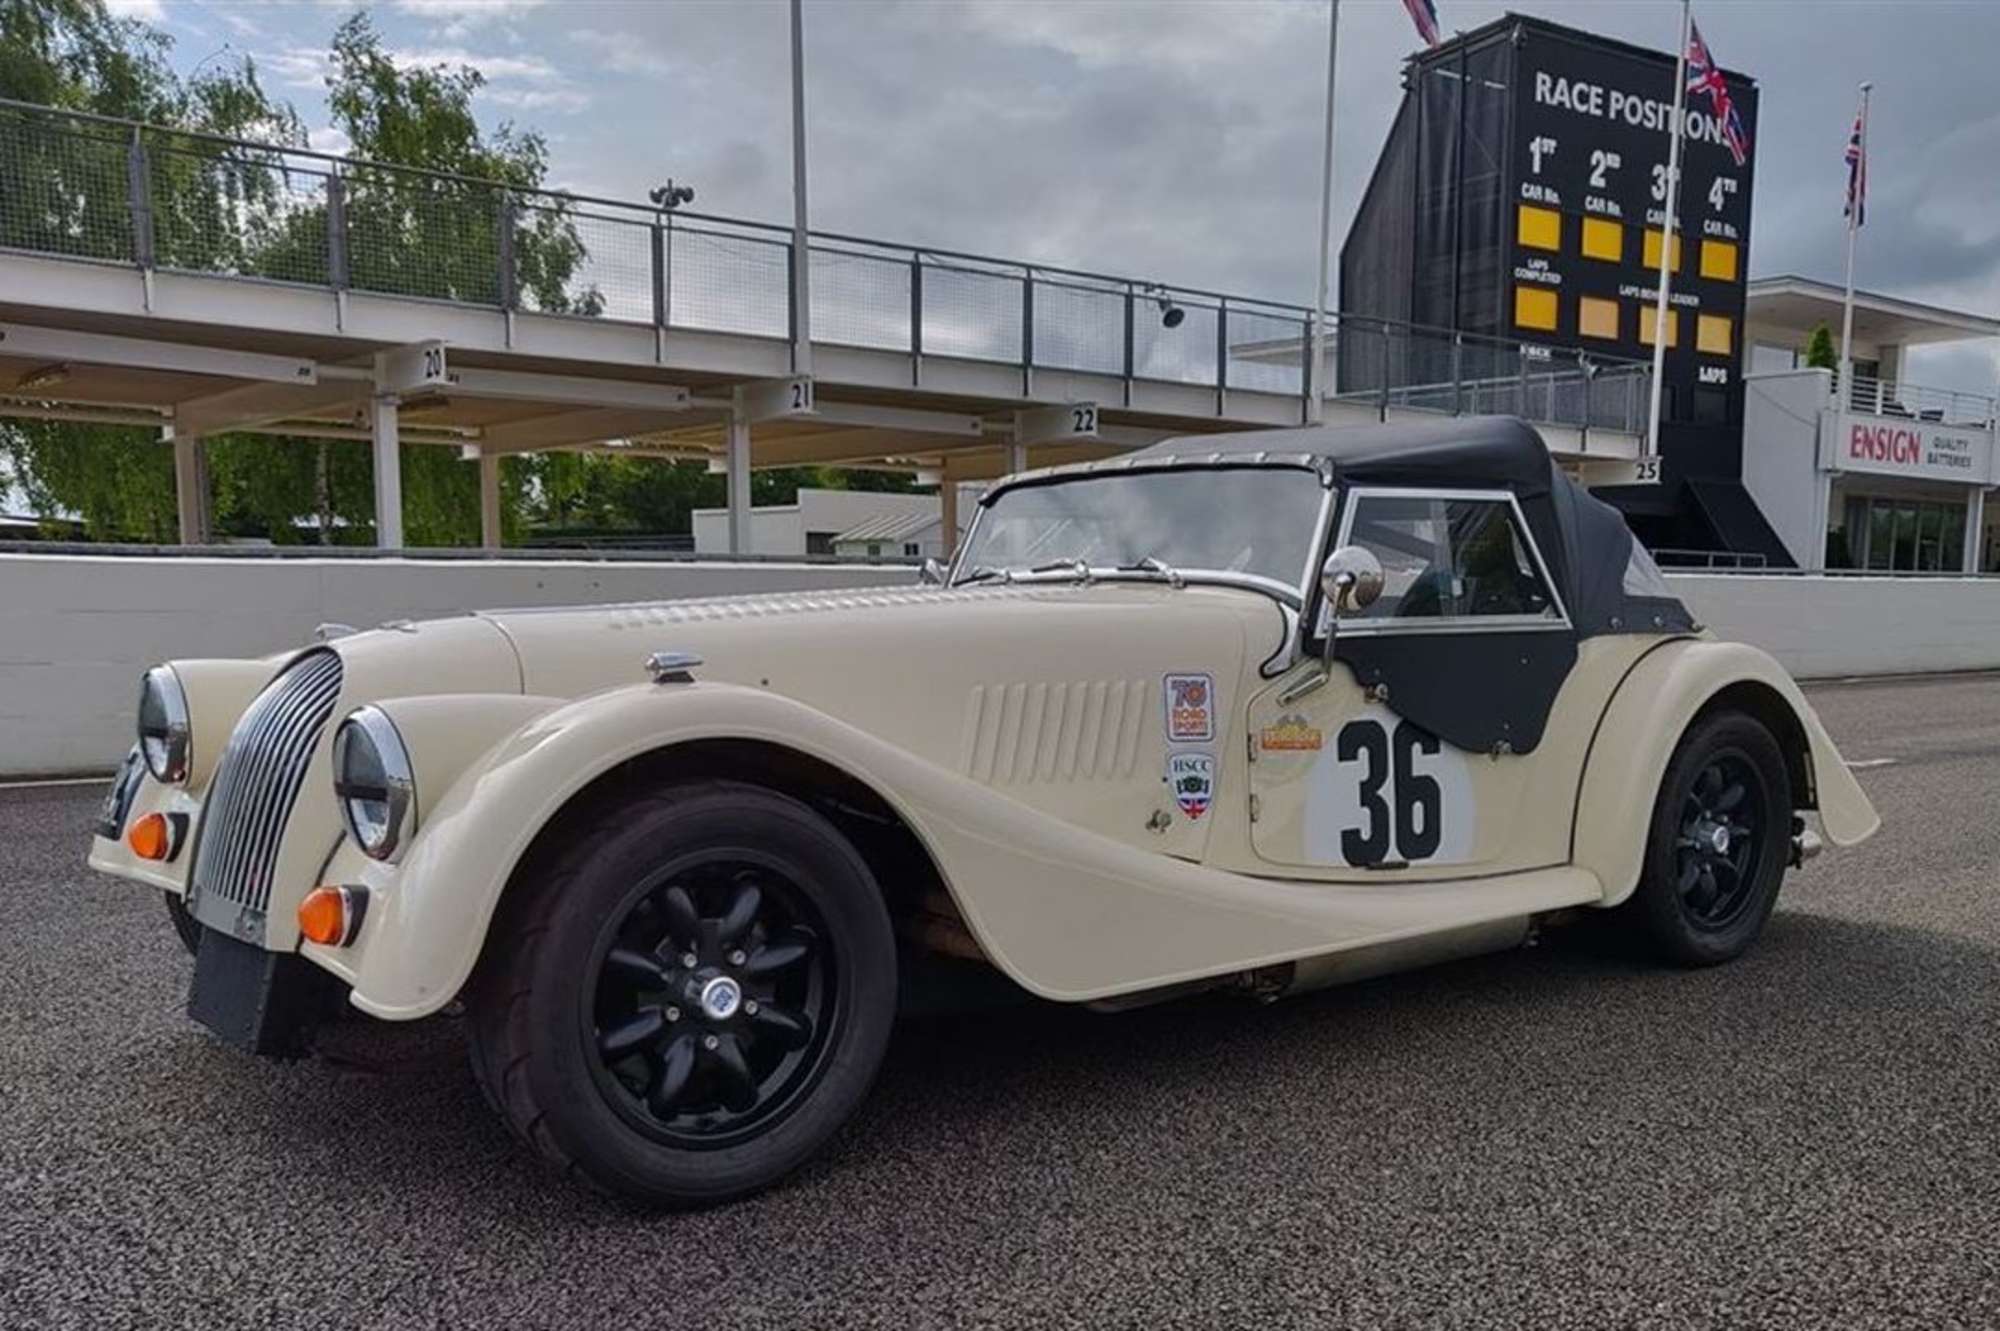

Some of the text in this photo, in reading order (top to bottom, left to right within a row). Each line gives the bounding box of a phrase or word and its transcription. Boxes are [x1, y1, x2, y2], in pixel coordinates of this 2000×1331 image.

[1535, 71, 1733, 148] RACE POSITION
[1521, 182, 1543, 201] CAR
[1708, 176, 1738, 212] 4TH
[1584, 195, 1606, 213] CAR
[1703, 218, 1723, 236] CAR
[1527, 258, 1550, 272] LAPS
[1514, 266, 1563, 285] COMPLETED
[1619, 283, 1640, 299] LAPS
[424, 347, 442, 379] 20
[1699, 365, 1728, 385] LAPS
[791, 383, 809, 409] 21
[1073, 407, 1095, 432] 22
[1850, 423, 1922, 465] ENSIGN
[1636, 462, 1657, 480] 25
[1337, 718, 1441, 868] 36
